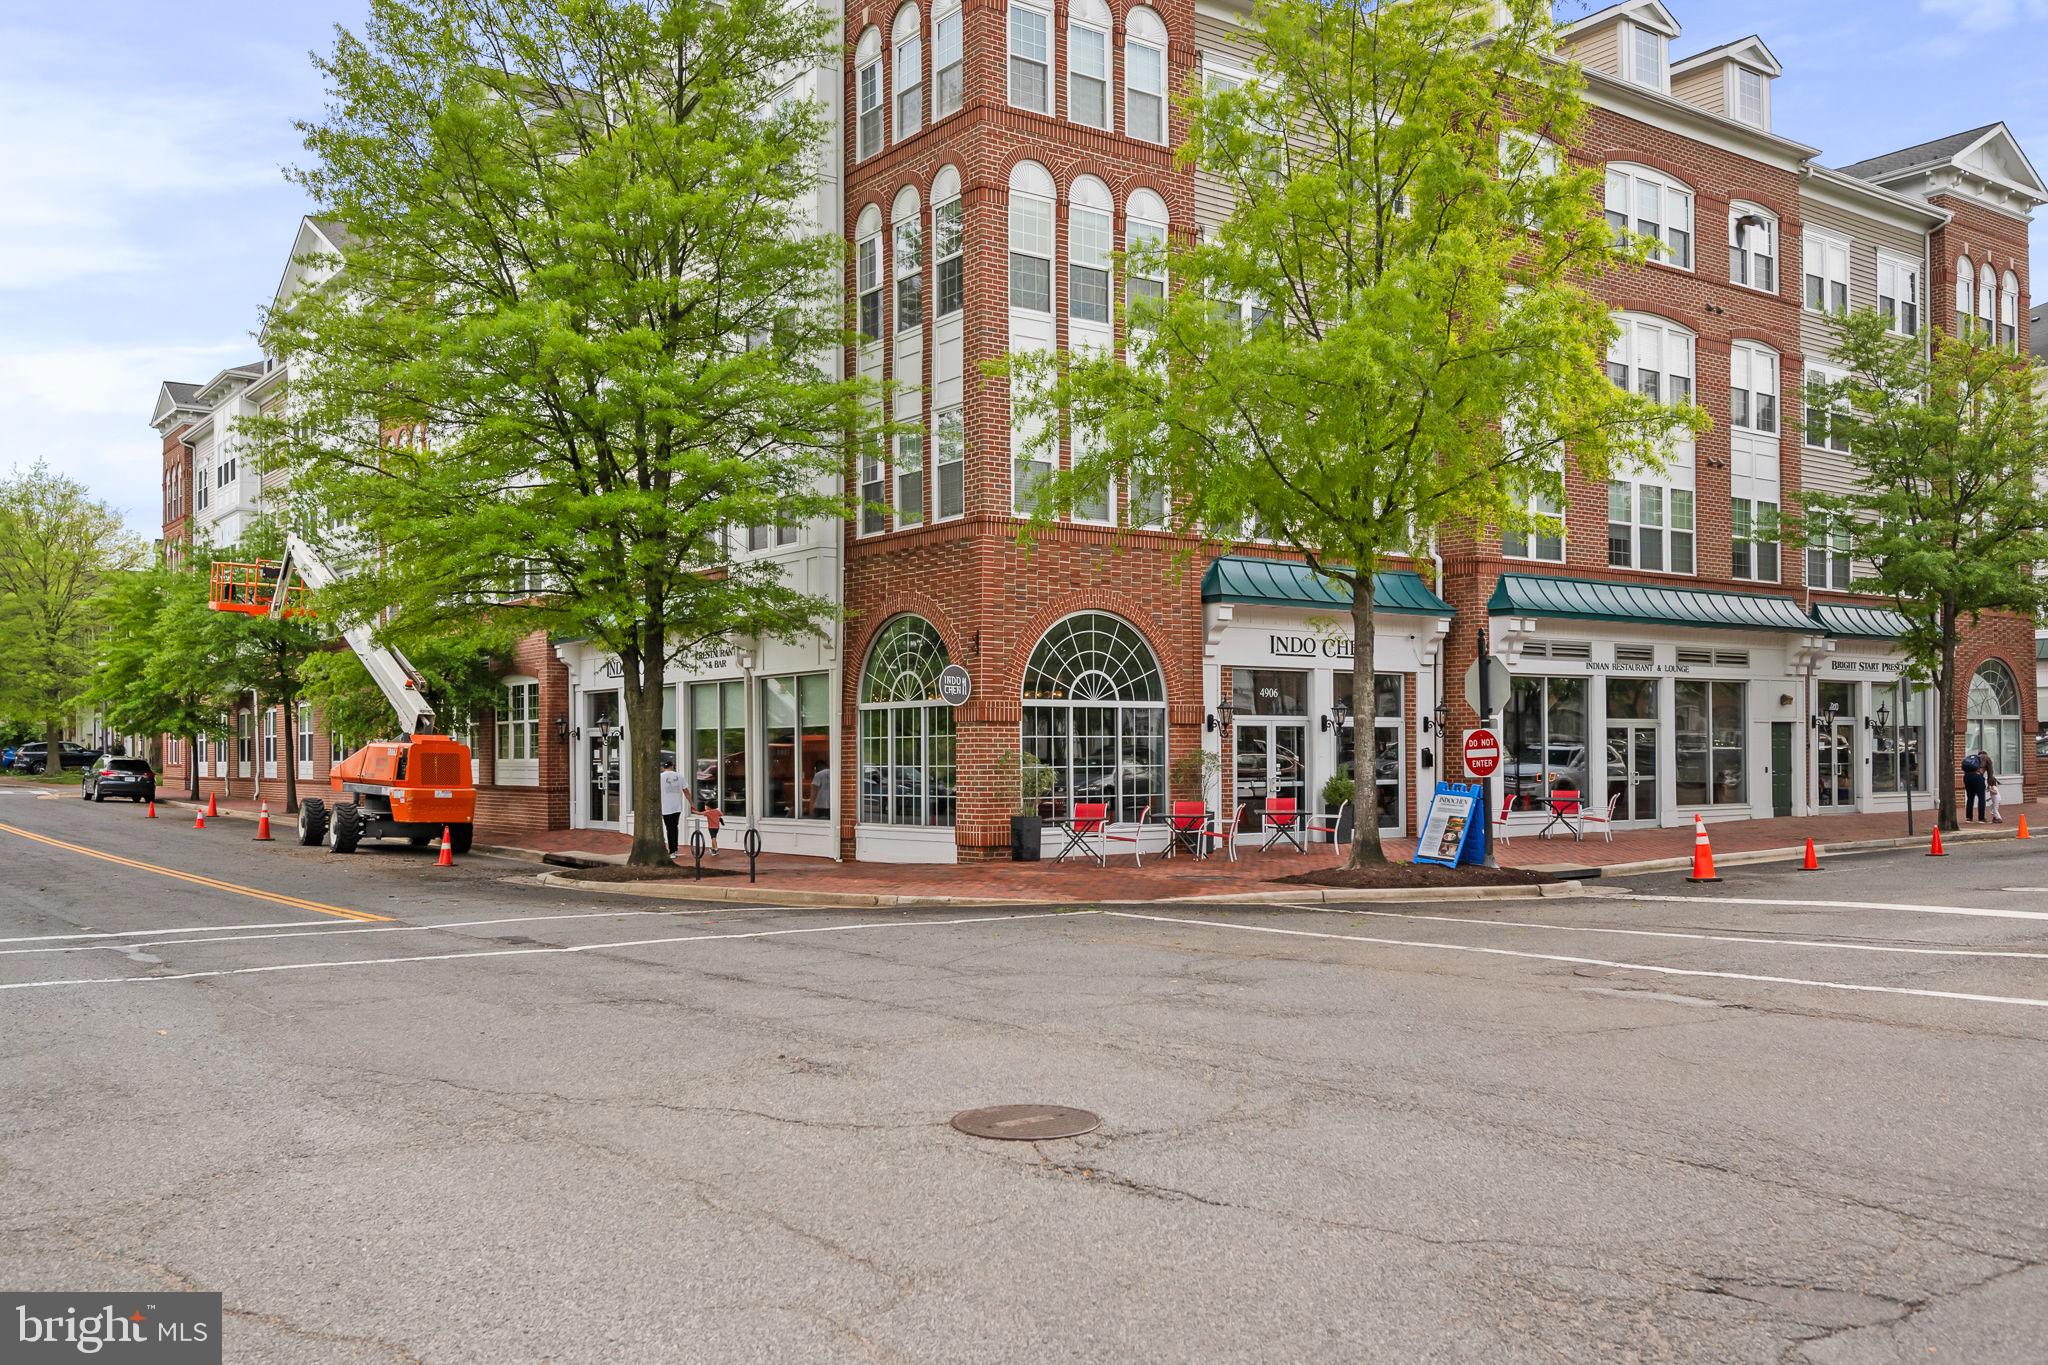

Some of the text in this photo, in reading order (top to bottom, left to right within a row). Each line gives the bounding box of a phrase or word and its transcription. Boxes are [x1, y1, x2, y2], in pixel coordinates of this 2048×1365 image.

[1270, 635, 1355, 658] INDO CH
[607, 660, 625, 677] IND
[714, 660, 727, 669] BAR
[1586, 662, 1609, 670] INDIAN
[1612, 663, 1653, 671] RESTAURANT
[1665, 665, 1689, 673] LOUNGE
[1832, 661, 1857, 671] BRIGHT
[1859, 661, 1879, 672] START
[944, 676, 961, 685] INDO
[944, 685, 961, 695] CHEN
[1260, 688, 1278, 698] 4906
[1469, 738, 1494, 747] DO NOT
[1472, 760, 1493, 768] ENTER
